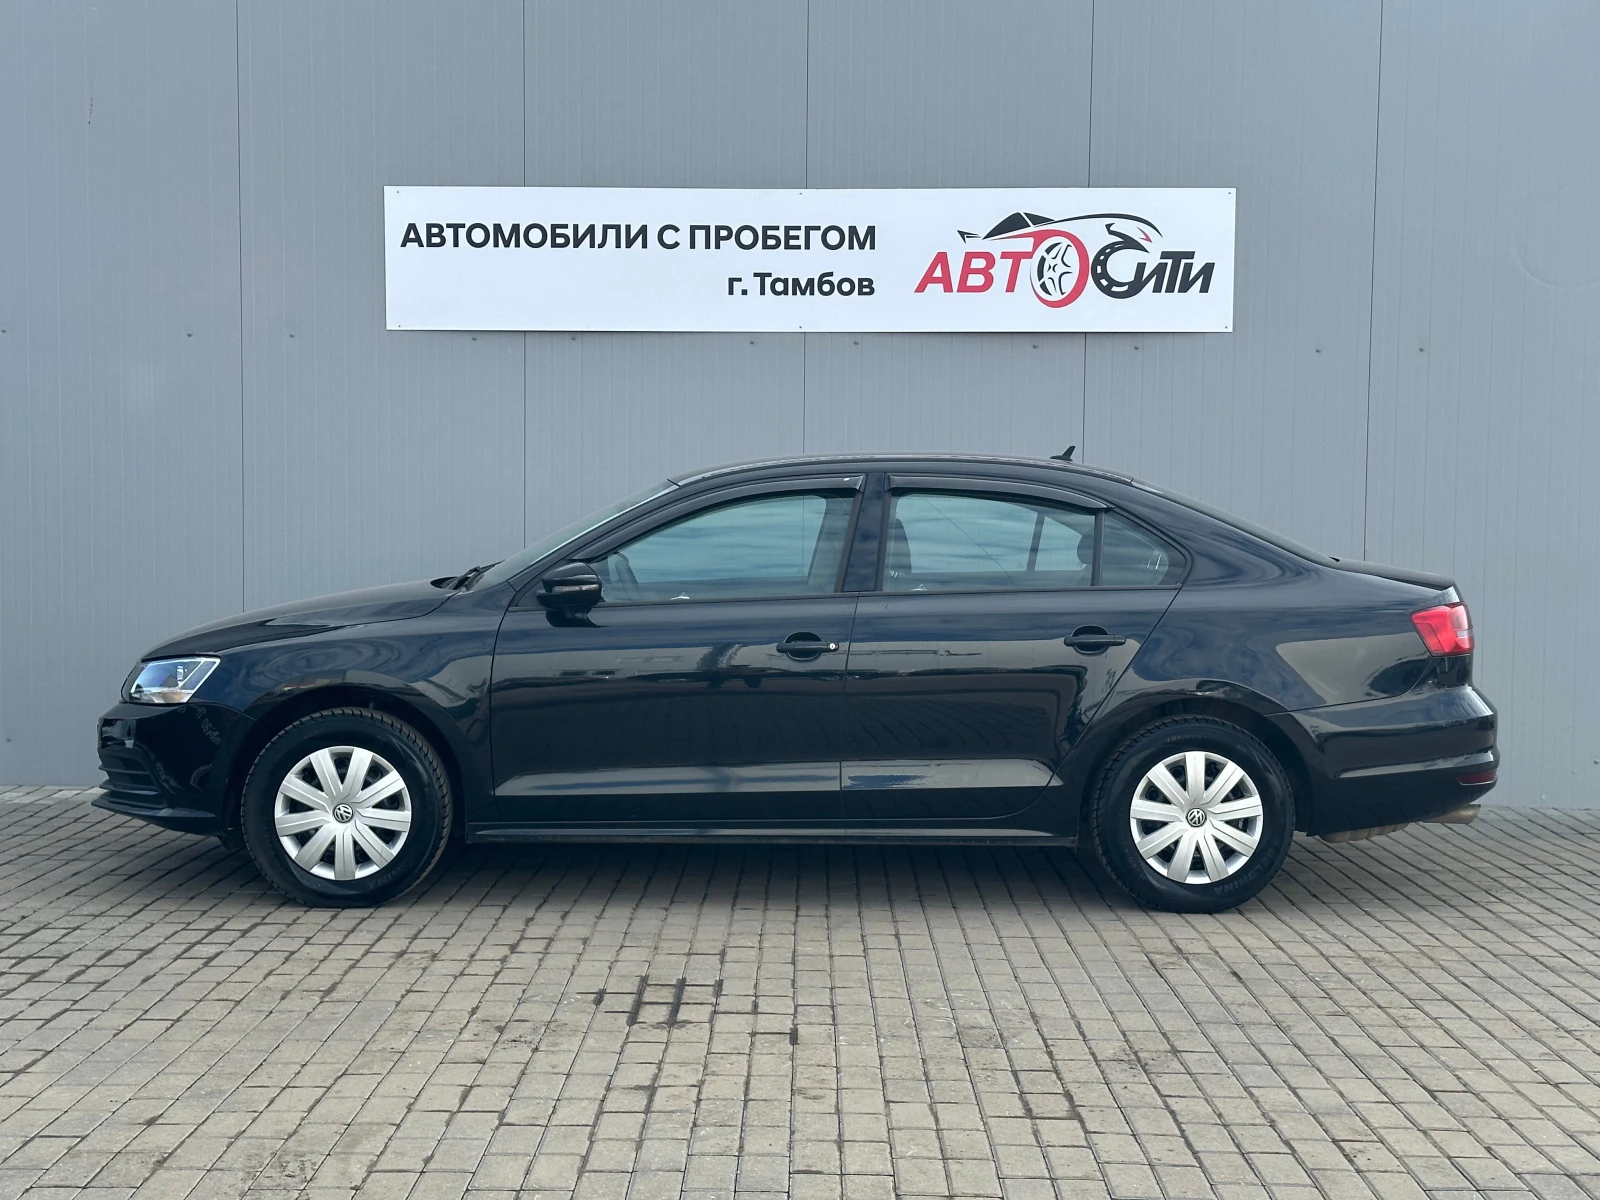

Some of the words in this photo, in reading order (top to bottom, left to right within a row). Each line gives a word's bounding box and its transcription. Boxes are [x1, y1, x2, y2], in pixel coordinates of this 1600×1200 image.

[400, 222, 648, 249] АВТОМОБИЛИ
[657, 224, 681, 250] С
[689, 224, 876, 251] ПРОБЕГОМ
[752, 271, 875, 297] Тамбов
